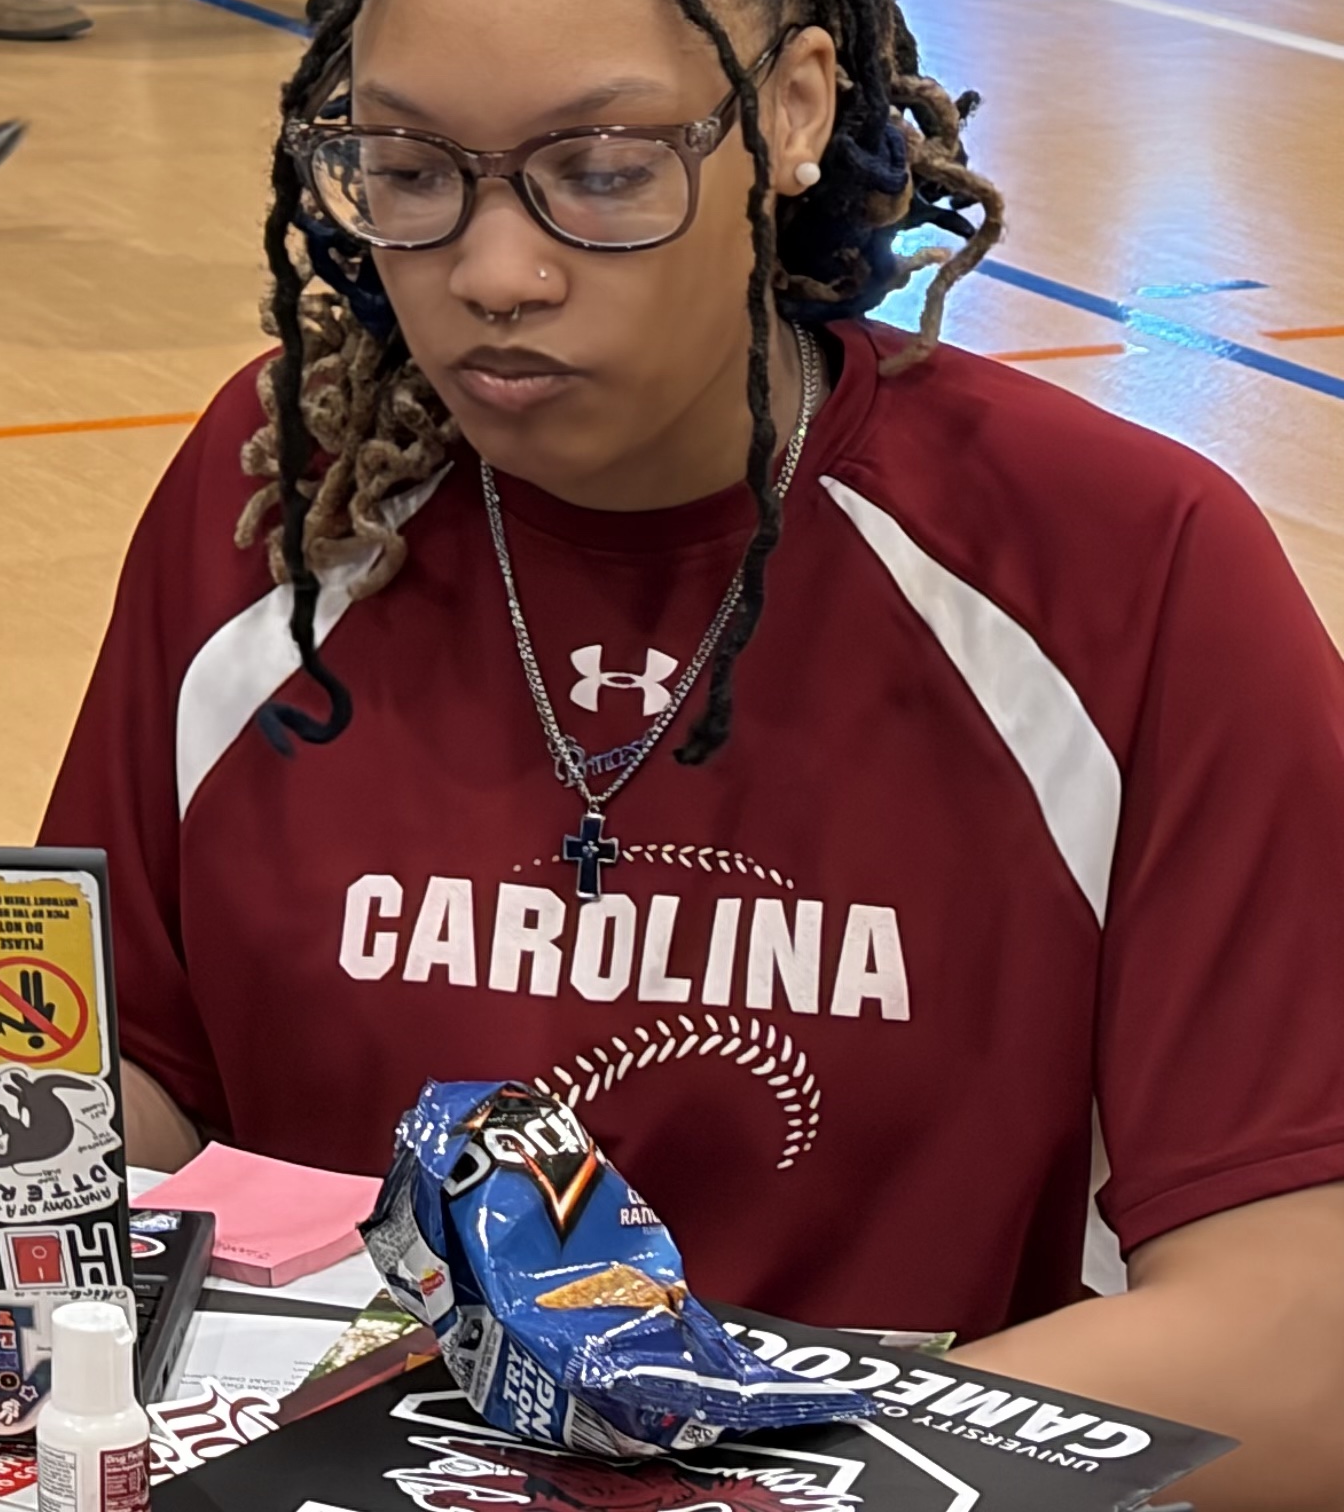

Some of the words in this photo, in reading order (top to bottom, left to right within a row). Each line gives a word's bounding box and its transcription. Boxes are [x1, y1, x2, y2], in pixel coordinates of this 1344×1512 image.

[25, 921, 43, 934] DO
[0, 937, 44, 951] PLEASE
[339, 874, 911, 1021] CAROLINA
[20, 1203, 37, 1216] OF
[42, 1187, 112, 1214] ANATOMY
[620, 1206, 662, 1226] RAN
[502, 1342, 522, 1402] TRY
[720, 1322, 1153, 1460] GAMECOC
[912, 1416, 1100, 1473] UNIVERSITY
